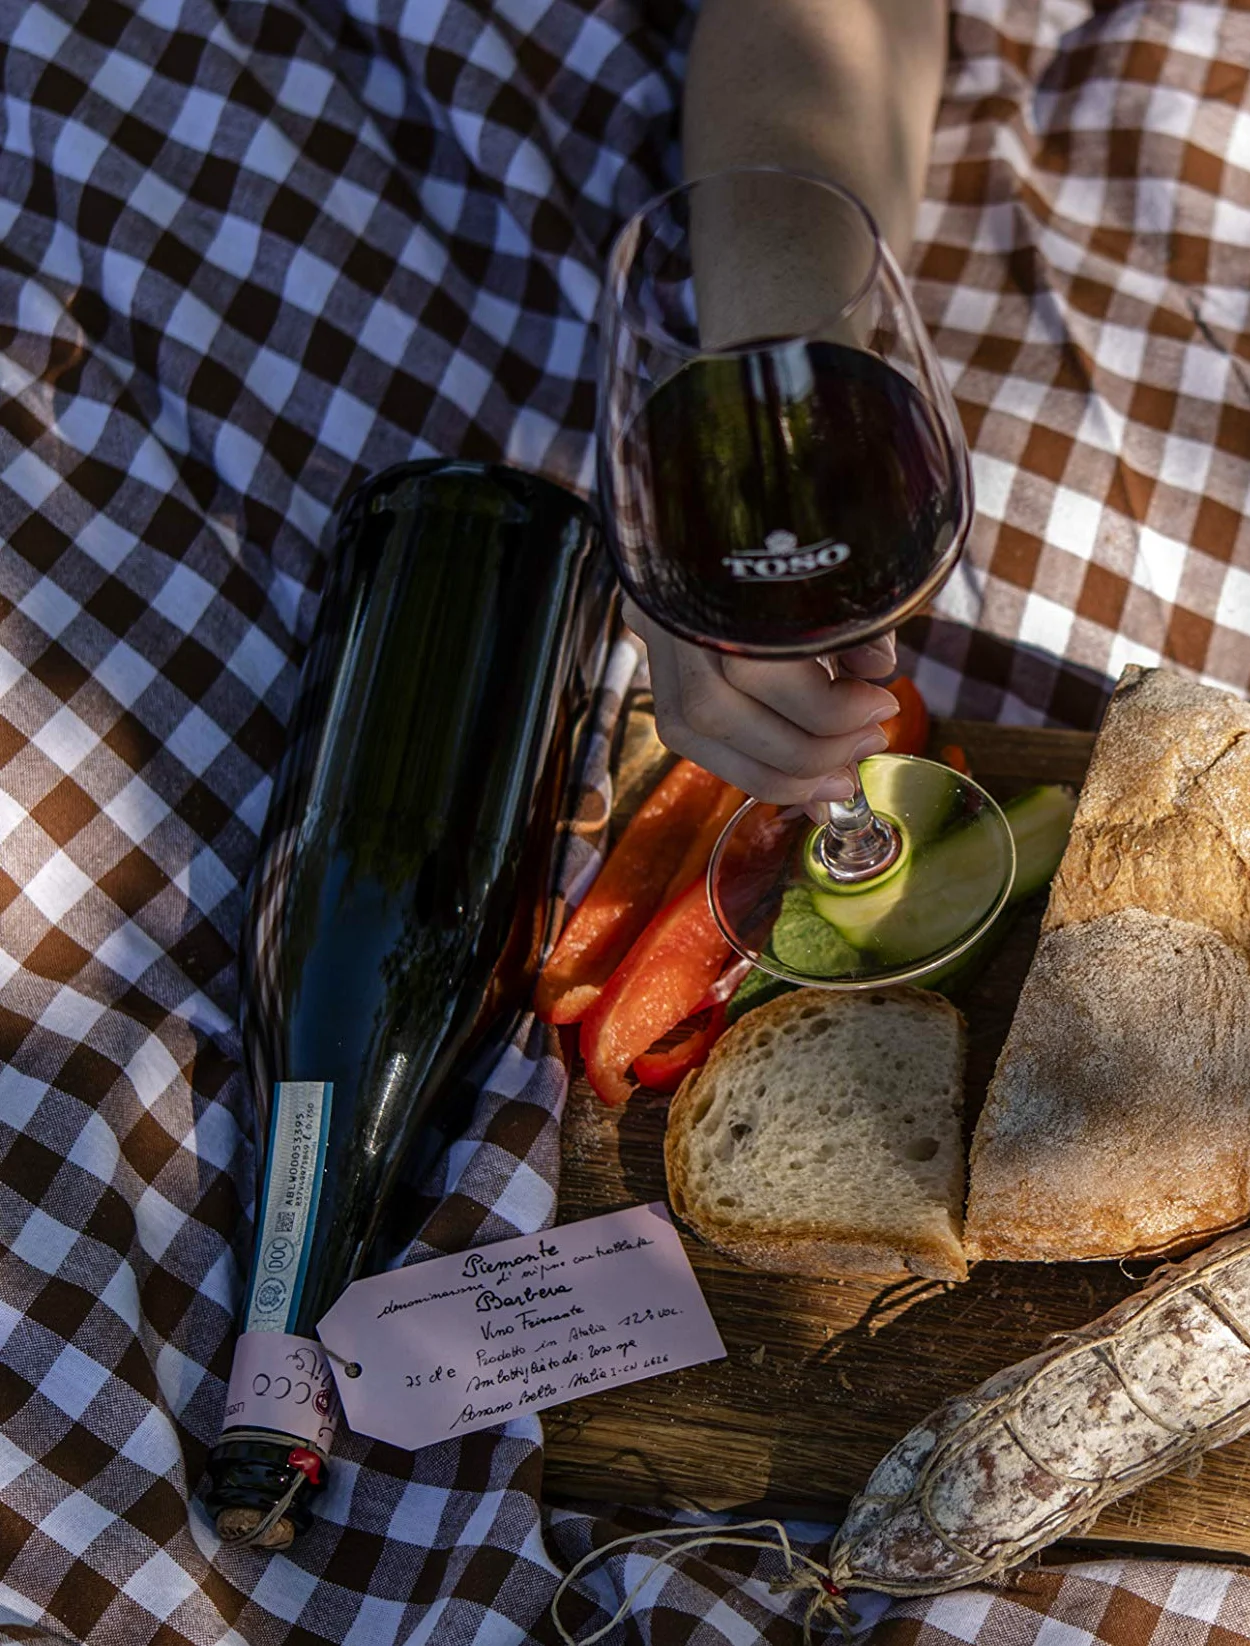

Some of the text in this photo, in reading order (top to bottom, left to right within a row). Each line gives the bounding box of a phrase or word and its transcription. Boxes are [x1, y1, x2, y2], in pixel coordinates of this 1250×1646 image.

[721, 543, 850, 577] TOSO
[268, 1242, 288, 1269] DOC
[462, 1240, 559, 1278] Piemonte
[475, 1283, 573, 1313] Barbera
[480, 1320, 515, 1341] Vino
[476, 1346, 526, 1368] Prodotto
[534, 1339, 557, 1353] in
